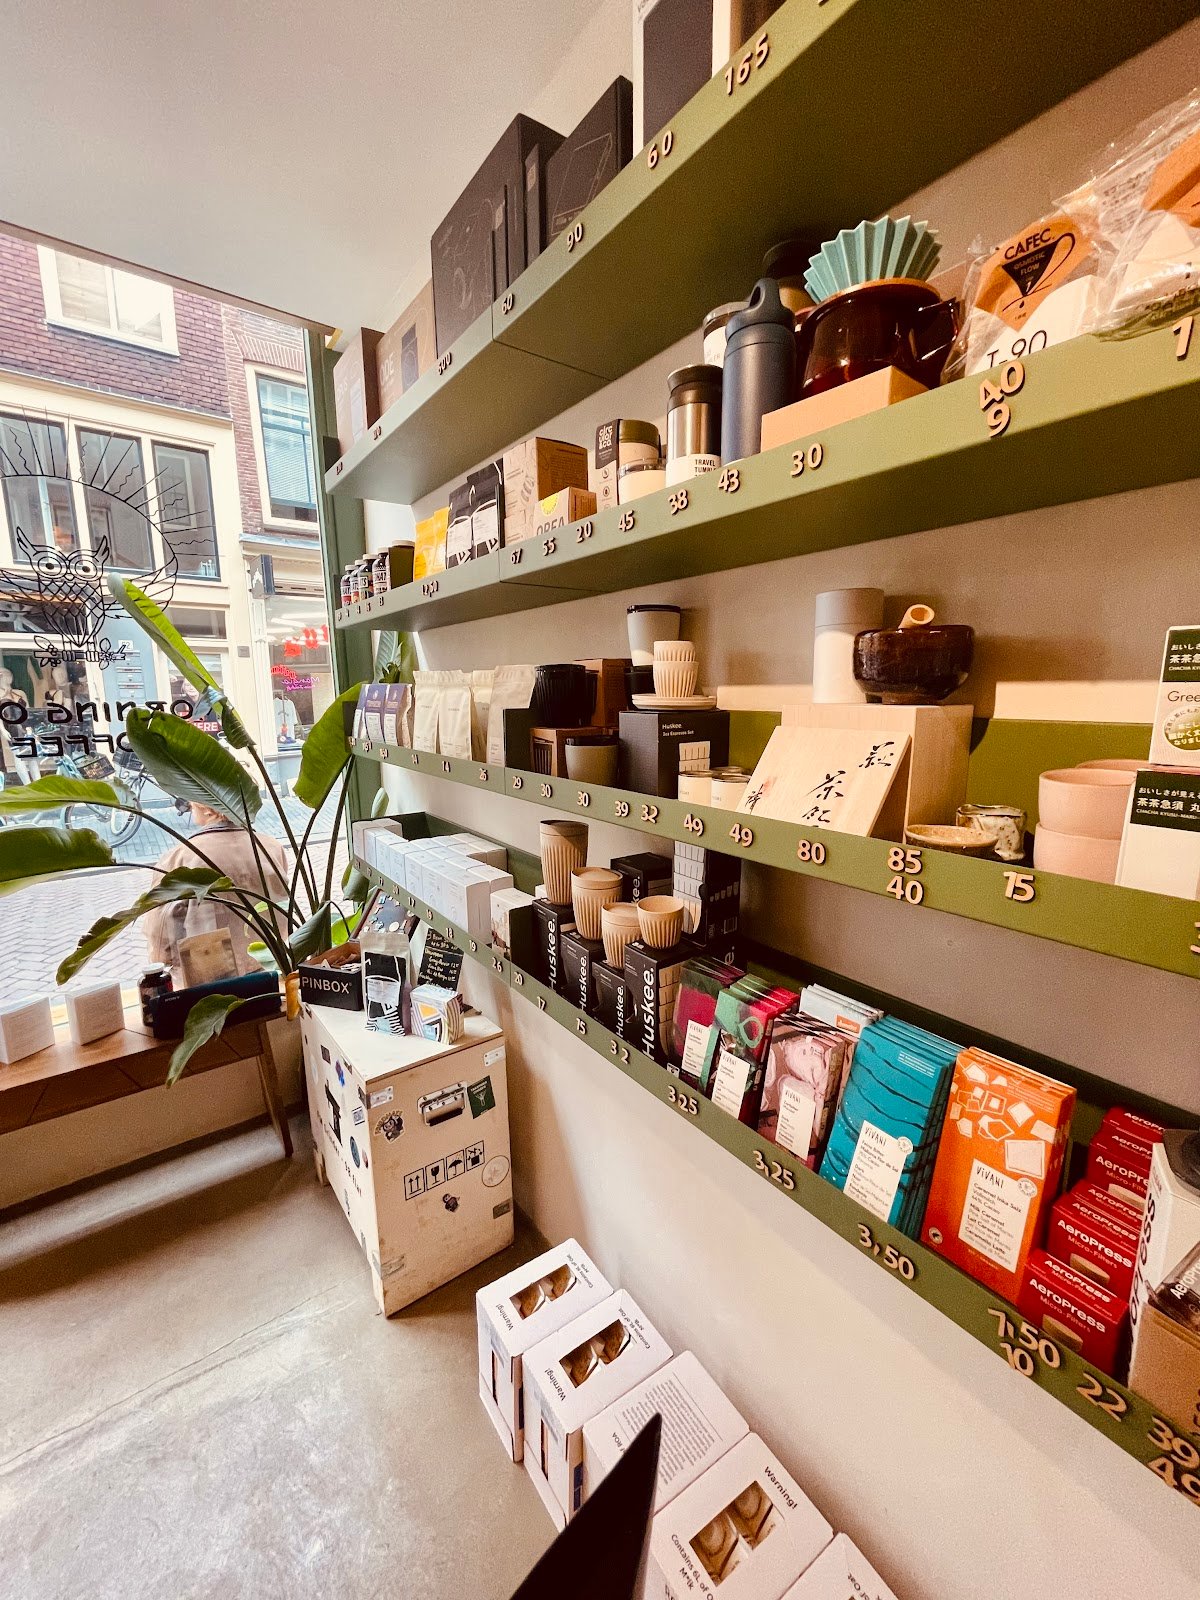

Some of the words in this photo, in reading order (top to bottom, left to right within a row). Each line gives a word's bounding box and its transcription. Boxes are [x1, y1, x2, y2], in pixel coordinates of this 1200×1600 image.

[725, 33, 769, 96] 165
[647, 130, 674, 169] 60
[566, 222, 584, 252] 90
[1005, 228, 1050, 260] CAFEC
[1021, 263, 1040, 275] FLOW
[501, 293, 515, 315] 60
[979, 360, 1025, 411] 40
[987, 402, 1012, 437] 9
[695, 458, 716, 467] TRAVEL
[790, 443, 823, 476] 30
[717, 468, 740, 493] 43
[668, 489, 688, 515] 38
[576, 521, 593, 543] 20
[618, 510, 635, 532] 45
[510, 548, 523, 564] 67
[542, 537, 556, 556] 55
[513, 776, 523, 789] 29
[541, 783, 552, 798] 30
[577, 791, 590, 807] 30
[615, 800, 629, 817] 39
[641, 804, 658, 824] 32
[684, 813, 704, 836] 49
[729, 823, 753, 847] 49
[797, 839, 826, 865] 80
[887, 847, 922, 874] 85
[887, 875, 923, 905] 40
[1003, 871, 1036, 902] 15
[469, 939, 477, 952] 19
[492, 957, 503, 973] 26
[514, 971, 524, 986] 20
[302, 976, 350, 995] PINBOX
[537, 996, 546, 1011] 17
[616, 985, 625, 1039] Huskee.
[641, 967, 656, 1060] Huskee.
[576, 1017, 587, 1036] 15
[611, 1040, 630, 1065] 32
[753, 1150, 796, 1191] 3,25
[1072, 1203, 1137, 1241] AeroPress
[857, 1223, 917, 1280] 3,50
[1058, 1220, 1133, 1268] AeroPress
[1044, 1260, 1111, 1303] AeroPress
[495, 1303, 514, 1331] Warning!
[1029, 1278, 1106, 1333] AeroPress
[987, 1308, 1062, 1369] 7,50
[1000, 1342, 1035, 1377] 10
[545, 1369, 566, 1401] Warning!
[1076, 1372, 1128, 1422] 22
[1147, 1415, 1200, 1470] 39
[764, 1466, 798, 1510] Warning!
[671, 1534, 694, 1570] Contains
[700, 1582, 710, 1593] of
